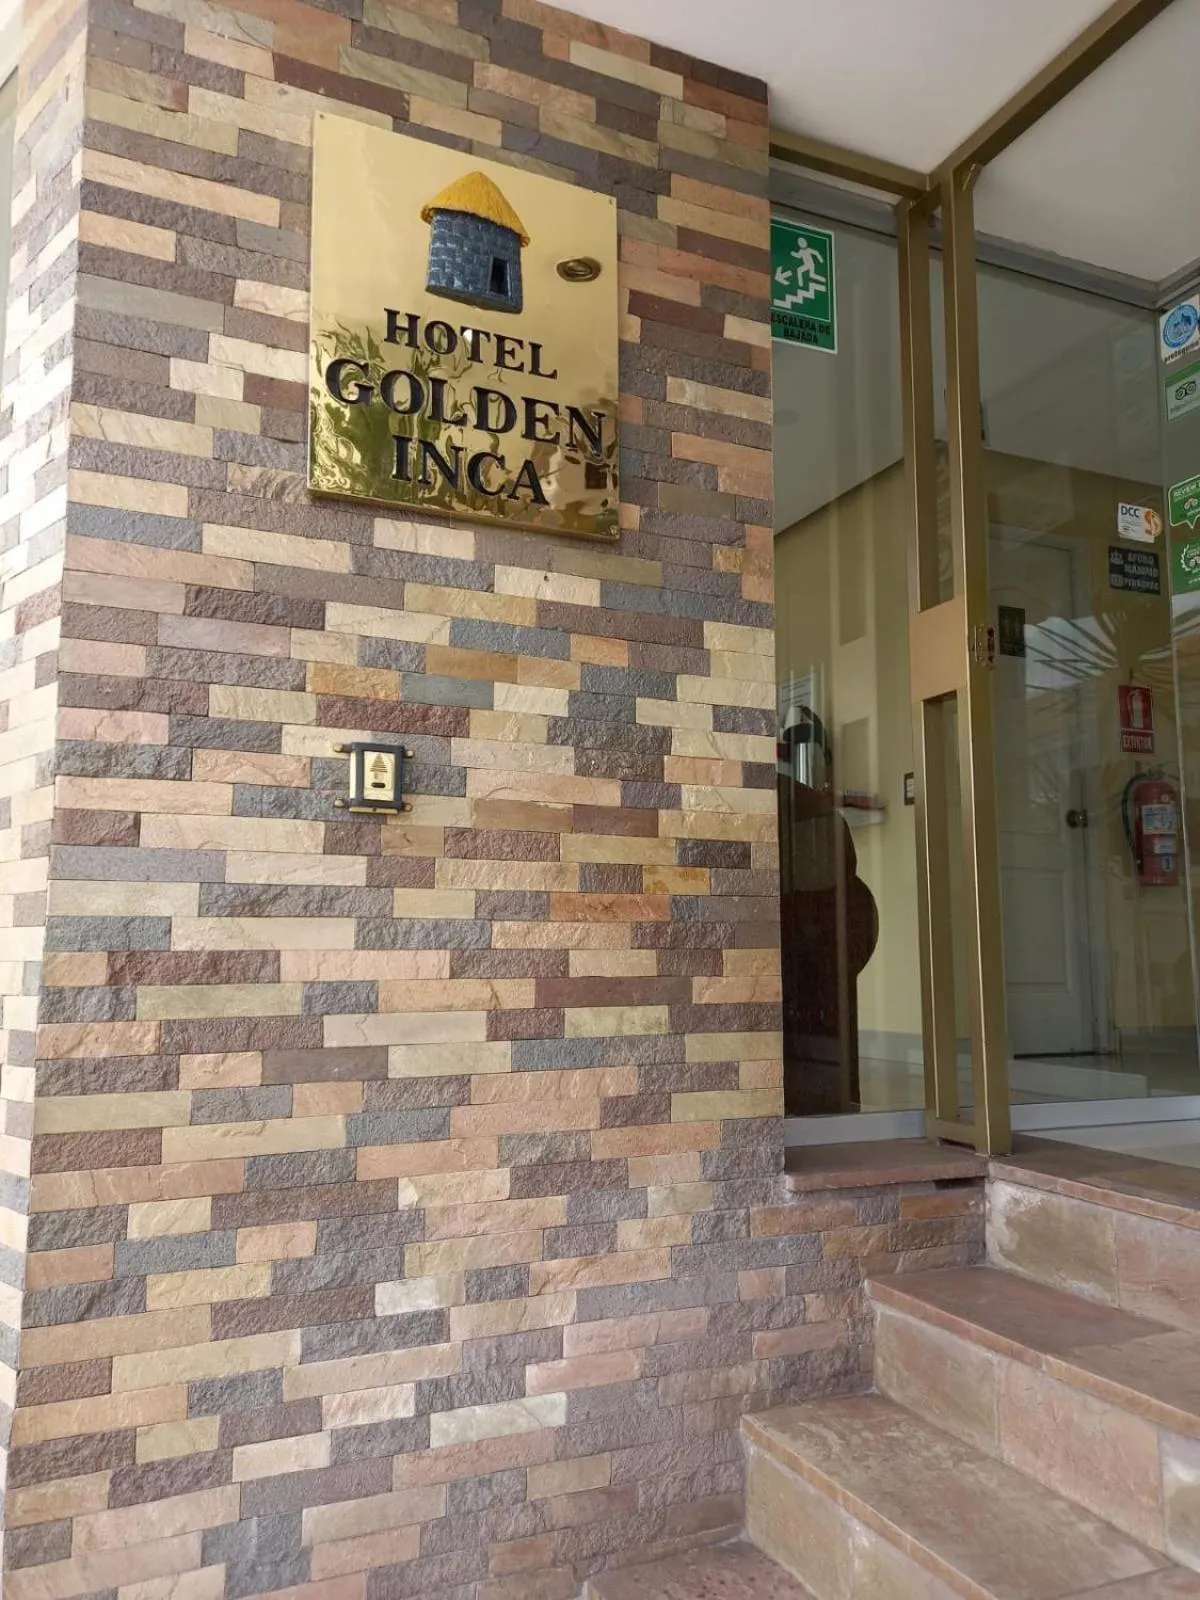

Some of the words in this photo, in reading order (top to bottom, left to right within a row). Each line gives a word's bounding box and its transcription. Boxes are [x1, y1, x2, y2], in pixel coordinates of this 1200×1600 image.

[383, 307, 558, 380] HOTEL
[325, 358, 606, 458] GOLDEN
[391, 435, 549, 506] INCA
[1121, 506, 1140, 518] DCC
